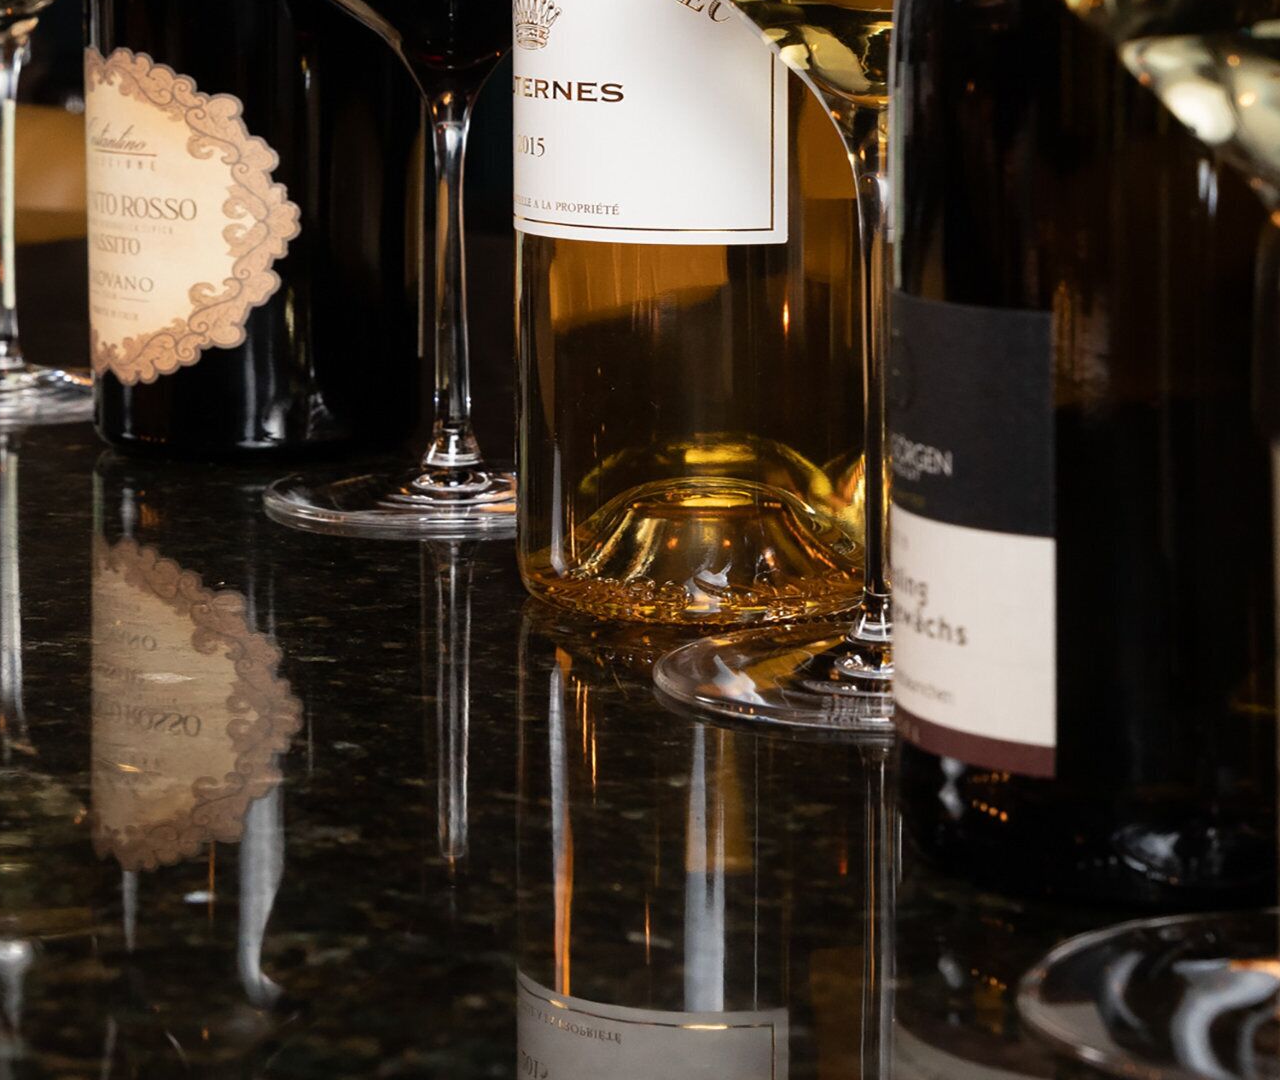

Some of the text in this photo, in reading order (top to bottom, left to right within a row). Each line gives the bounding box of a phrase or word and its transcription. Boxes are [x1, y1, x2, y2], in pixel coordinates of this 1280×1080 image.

[513, 75, 625, 103] TERNES
[517, 135, 546, 158] 2015
[121, 196, 198, 222] ROSSO
[555, 201, 621, 216] PROPRIÉTÉ
[94, 270, 155, 293] OVANO
